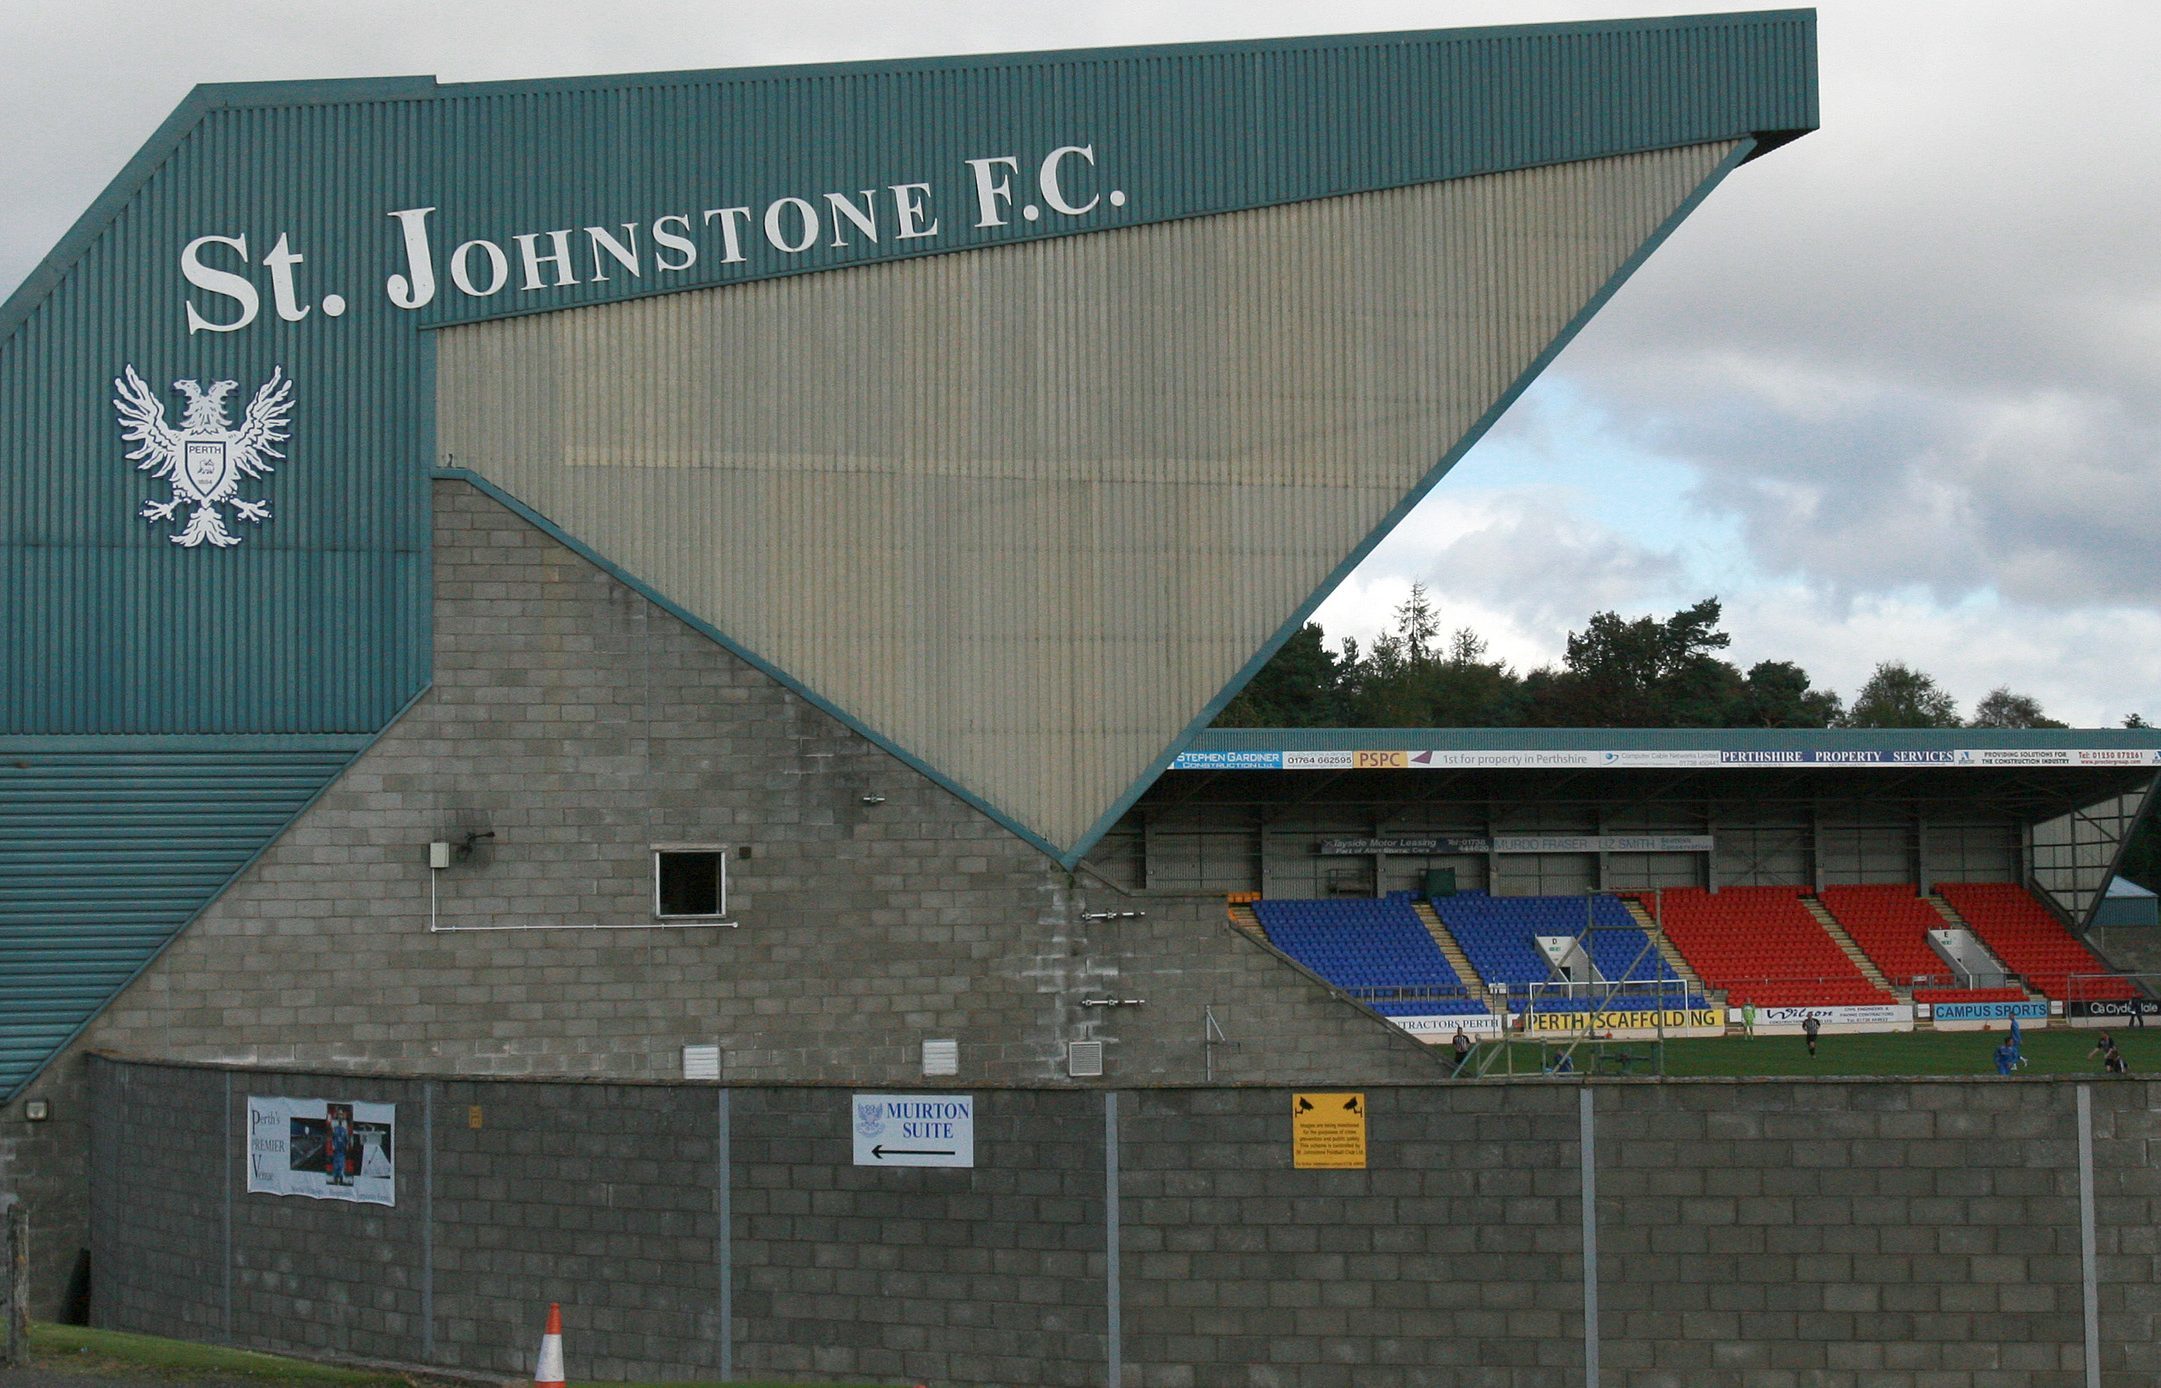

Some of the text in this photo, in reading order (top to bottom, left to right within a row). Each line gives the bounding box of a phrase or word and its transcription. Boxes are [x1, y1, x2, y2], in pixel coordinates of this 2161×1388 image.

[181, 144, 1126, 335] St. JOHNSTONE F.C.
[188, 445, 222, 454] PERTH
[1177, 752, 1280, 762] STEPHEN GARDINER
[1287, 756, 1315, 764] 01764
[1360, 752, 1400, 767] PSPC
[1443, 754, 1587, 766] 1st for property in Perthshire
[1722, 751, 1803, 762] PERTHSHIRE
[1815, 751, 1882, 762] PROPERTY
[1893, 750, 1953, 762] SERVICES
[1370, 839, 1397, 847] Motor
[1400, 839, 1437, 848] Leasing
[1542, 838, 1587, 849] FRASER
[1619, 838, 1655, 849] SMITH
[1766, 1007, 1833, 1020] Wilson
[1936, 1003, 1991, 1017] CAMPUS
[1995, 1003, 2047, 1017] SPORTS
[1463, 1019, 1498, 1028] PERTH
[1528, 1014, 1584, 1030] PERTH
[1597, 1010, 1715, 1028] SCAFFOLDNG
[887, 1103, 970, 1119] MUIRTON
[252, 1109, 281, 1135] Perth's
[903, 1122, 954, 1138] SUITE
[252, 1139, 285, 1152] PREMIER
